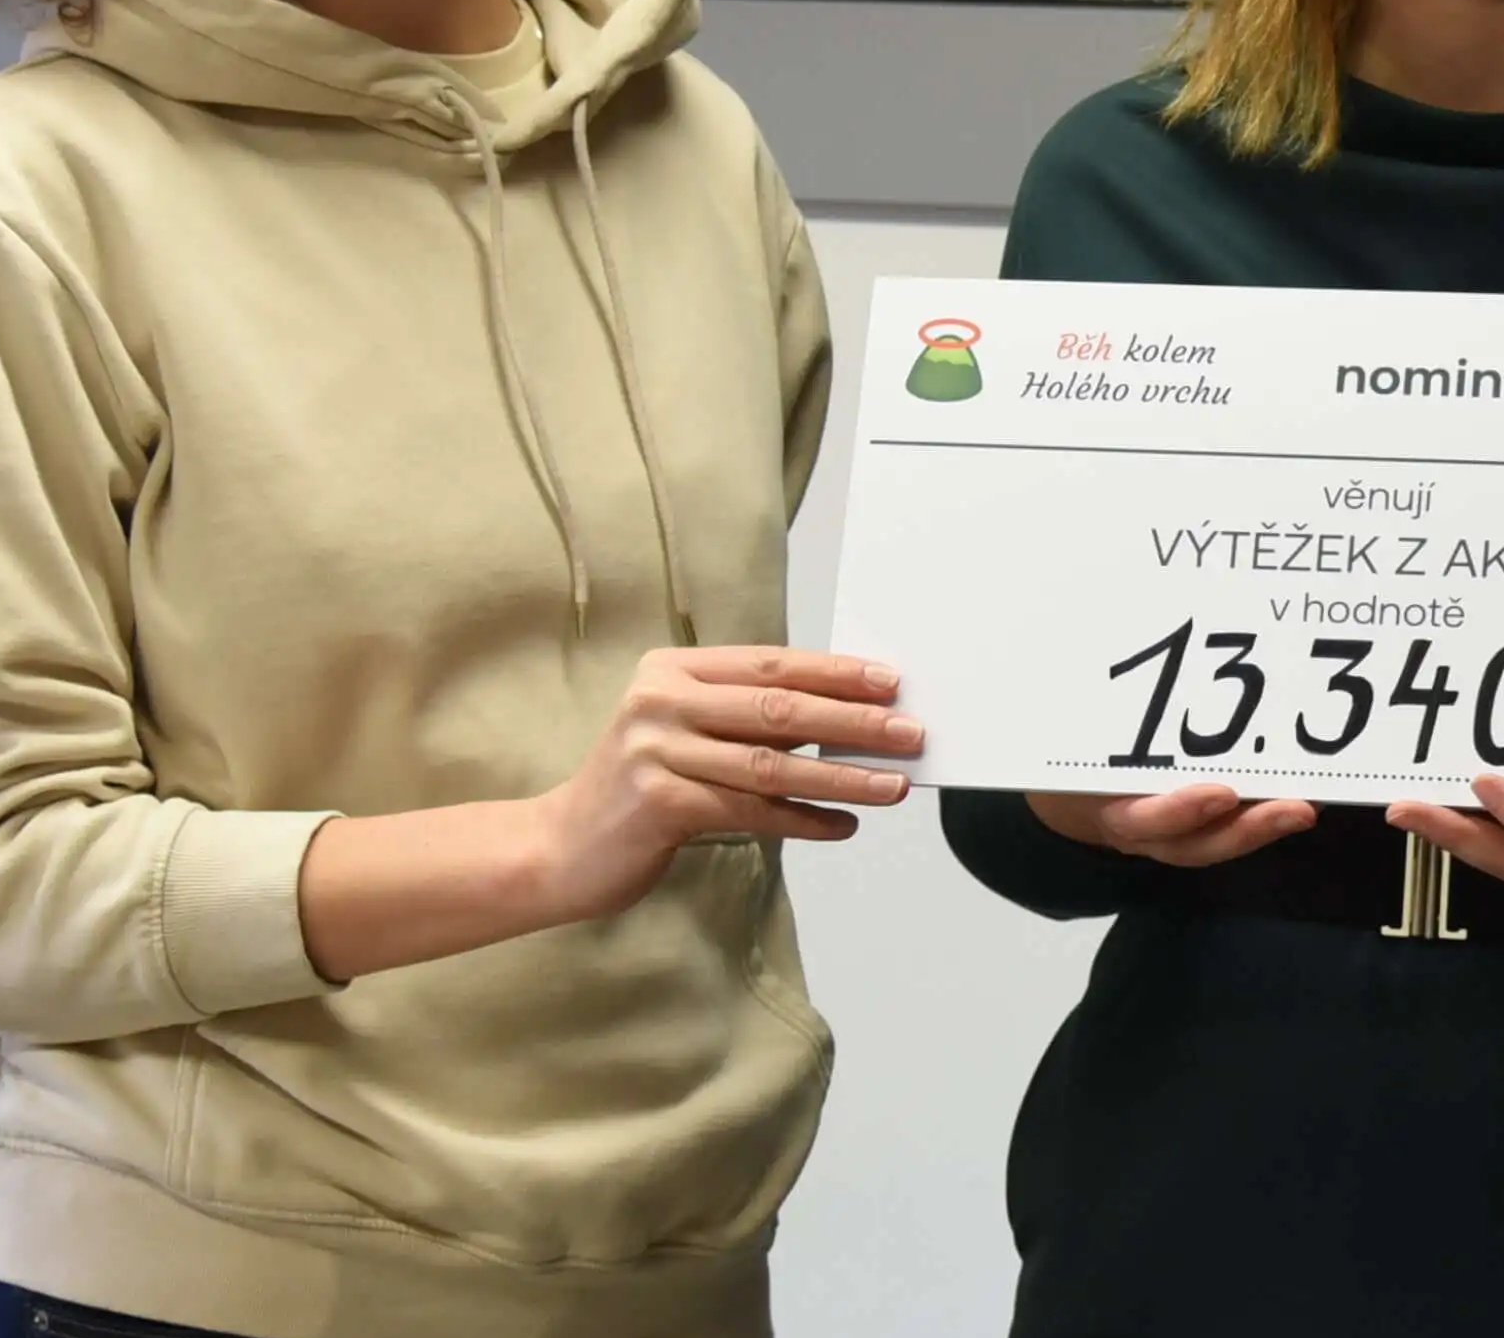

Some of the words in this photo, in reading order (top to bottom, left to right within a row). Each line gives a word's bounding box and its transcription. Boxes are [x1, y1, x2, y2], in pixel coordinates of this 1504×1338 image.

[1056, 332, 1113, 362] Běh
[1122, 333, 1217, 366] kolem
[1020, 372, 1130, 403] Holého
[1141, 375, 1232, 407] vrchu
[1322, 479, 1436, 519] věnují
[1151, 519, 1381, 576] VÝTĚŽEK
[1394, 537, 1429, 576] Z
[1269, 599, 1292, 623] v
[1301, 591, 1466, 629] hodnotě
